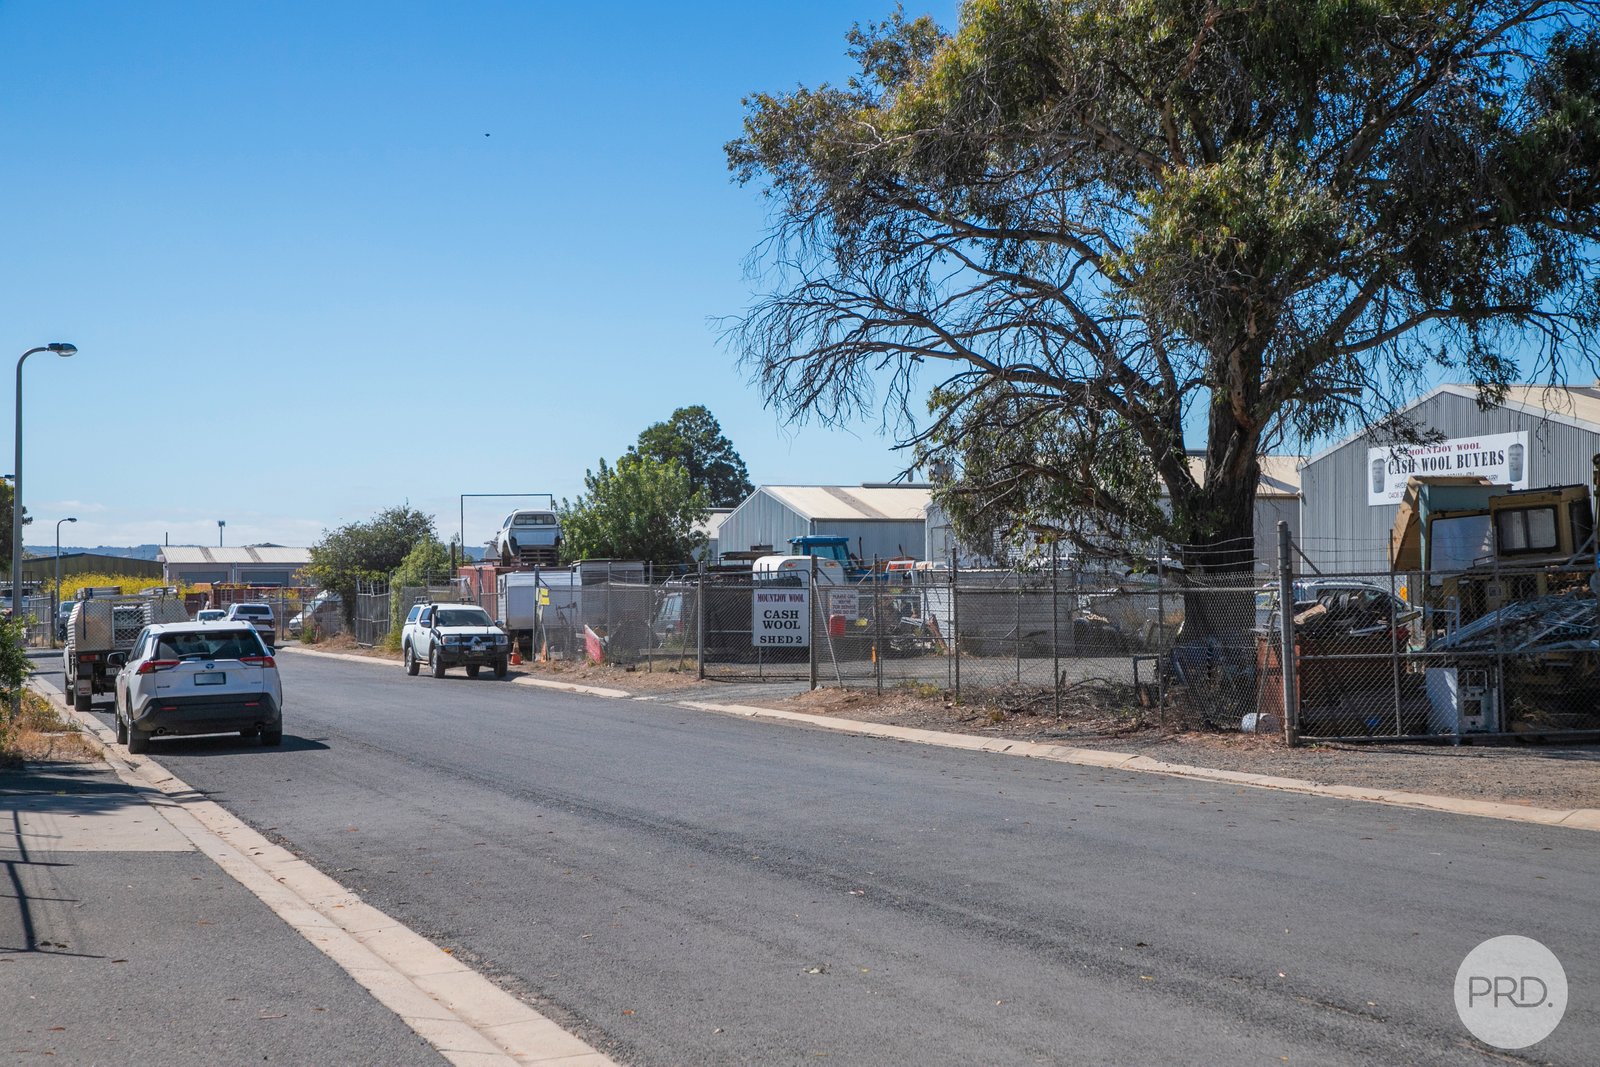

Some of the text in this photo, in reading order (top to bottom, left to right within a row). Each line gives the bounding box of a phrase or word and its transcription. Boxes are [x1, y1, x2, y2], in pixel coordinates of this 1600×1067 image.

[1407, 442, 1481, 456] MOUNTJOY WOOL
[1388, 457, 1416, 475] CASH
[1421, 455, 1452, 472] WOOL
[1457, 450, 1505, 469] BUYERS
[757, 593, 805, 603] MOUNTJOY WOOL
[763, 609, 799, 619] CASH
[762, 620, 800, 629] WOOL
[760, 635, 803, 644] SHED 2
